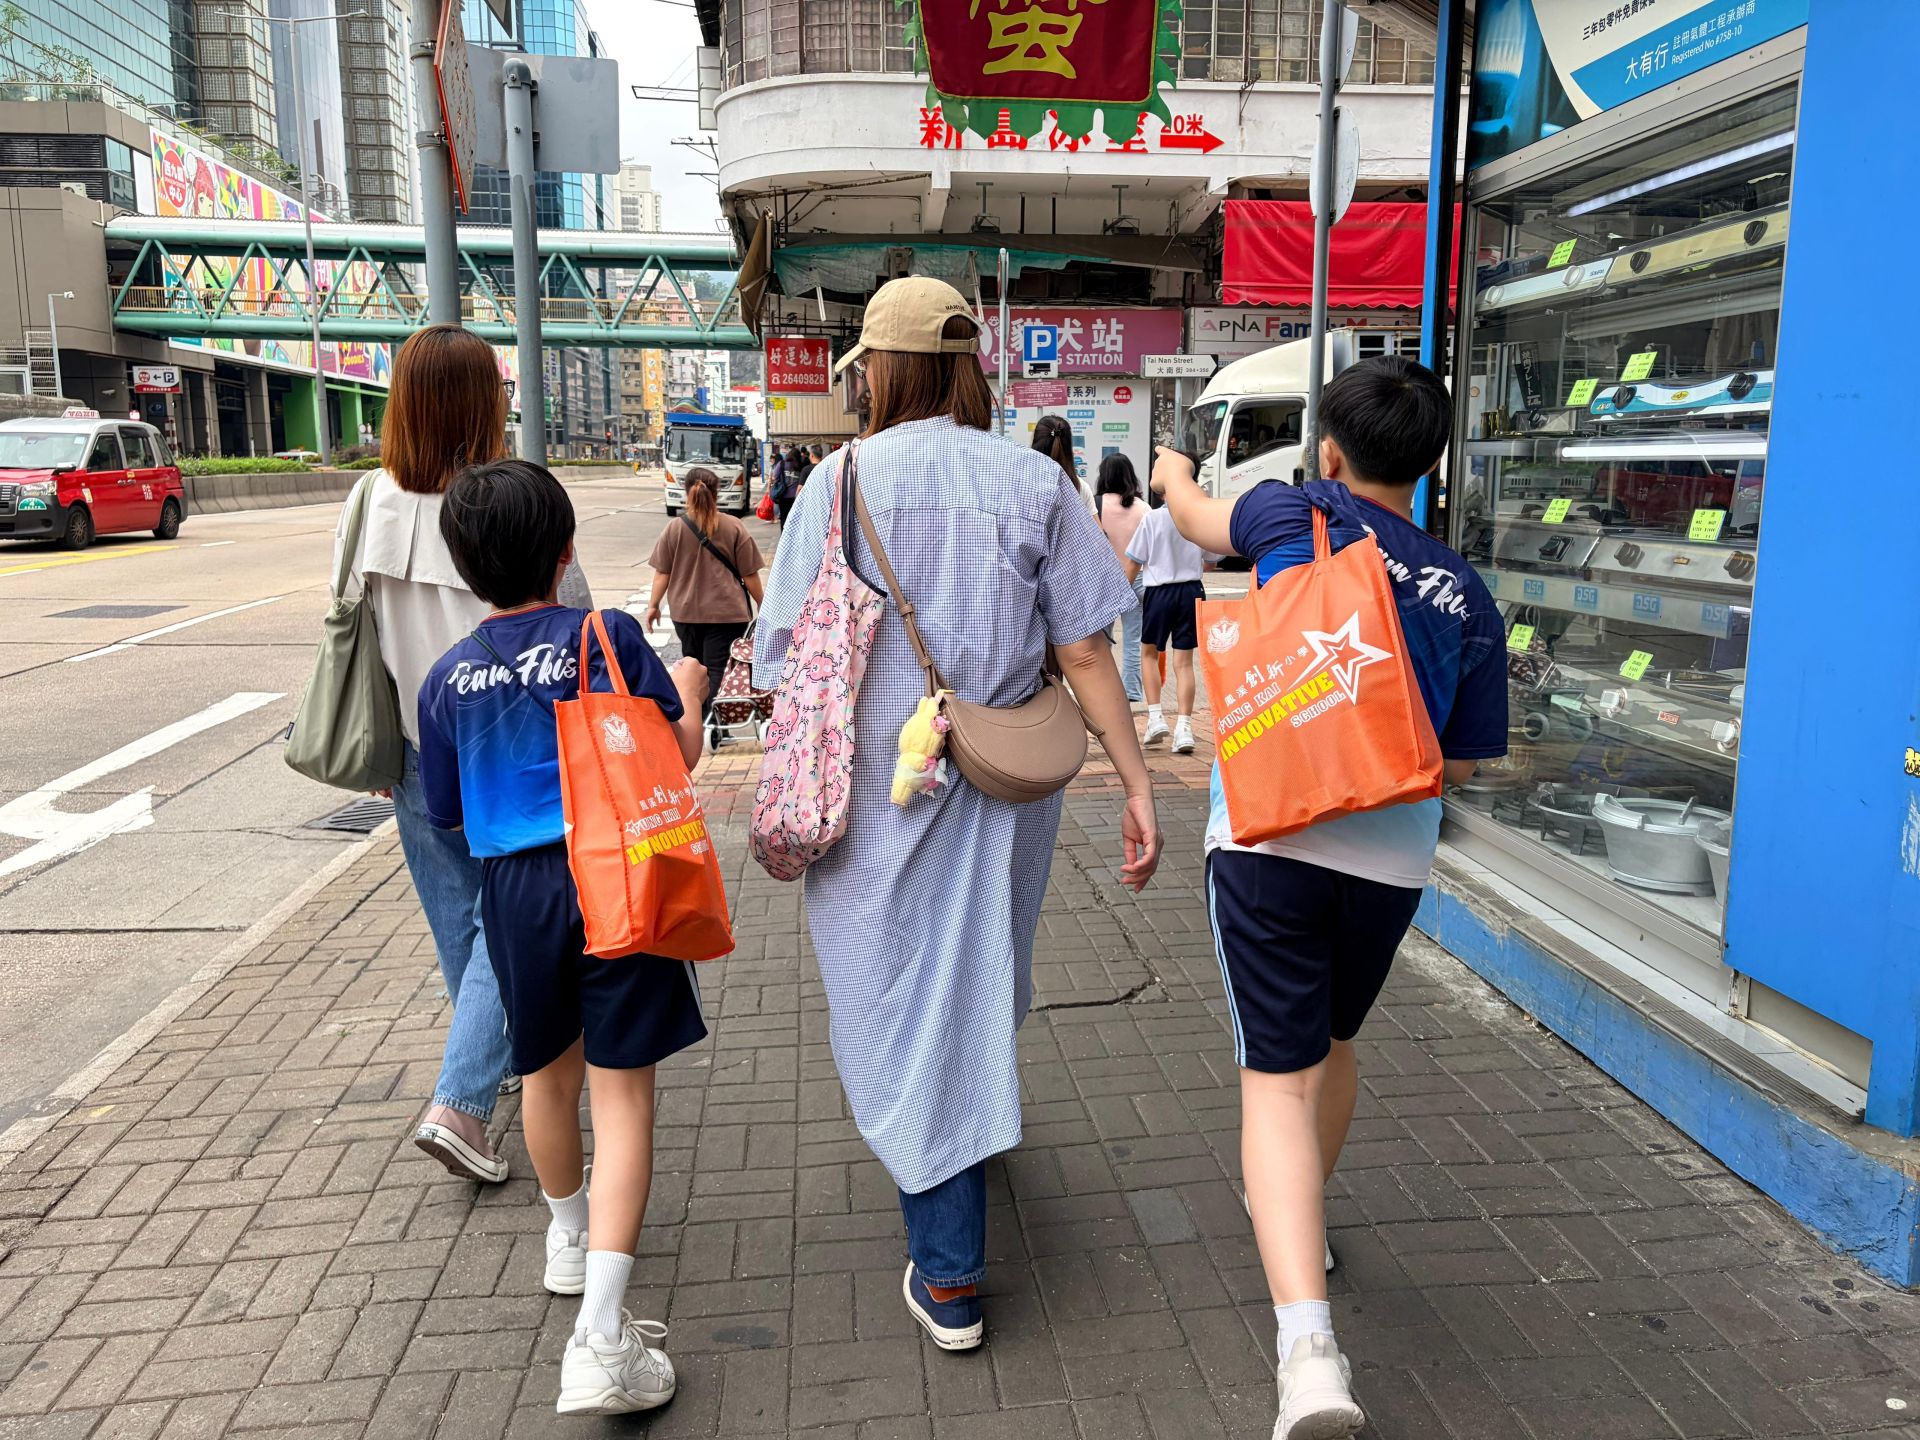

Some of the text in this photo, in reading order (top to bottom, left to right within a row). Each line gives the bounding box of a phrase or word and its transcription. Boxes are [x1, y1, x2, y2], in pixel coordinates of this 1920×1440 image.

[1671, 24, 1743, 65] Registered No #758-10
[1624, 42, 1670, 85] 大有行
[1200, 316, 1261, 338] APNA
[1031, 329, 1051, 359] P
[991, 353, 1016, 366] CT
[1066, 353, 1124, 366] STATION
[1157, 366, 1183, 375] 大南街
[782, 373, 825, 385] 26409828
[447, 643, 577, 695] Team Fkis
[1253, 681, 1282, 708] KAI
[1290, 690, 1347, 728] SCHOOL
[1219, 671, 1336, 763] INNOVATIVE
